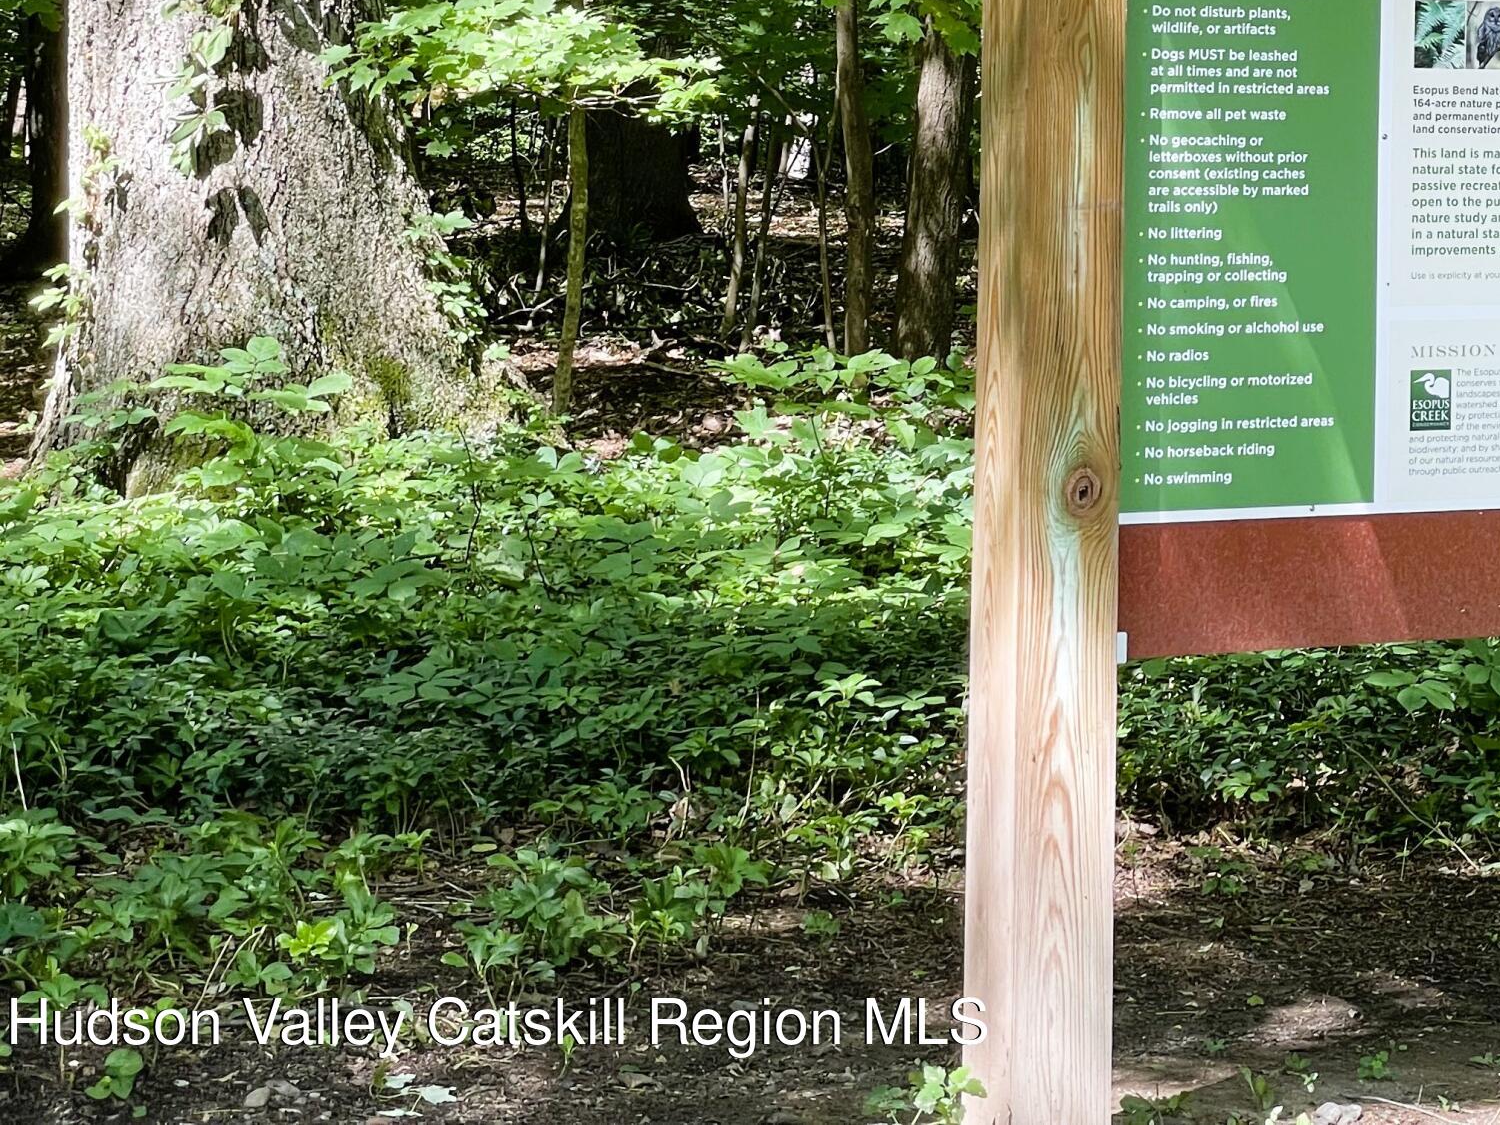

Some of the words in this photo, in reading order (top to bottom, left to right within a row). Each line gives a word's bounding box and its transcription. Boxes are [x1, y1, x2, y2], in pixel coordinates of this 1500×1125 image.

[1152, 4, 1171, 16] Do
[1174, 6, 1196, 17] not
[1199, 5, 1245, 18] disturb
[1248, 6, 1290, 21] plants,
[1151, 21, 1202, 35] wildlife,
[1206, 24, 1221, 34] or
[1223, 22, 1276, 35] artifacts
[1151, 48, 1185, 62] Dogs
[1188, 48, 1226, 60] MUST
[1229, 48, 1245, 60] be
[1248, 49, 1297, 61] leashed
[1150, 81, 1214, 94] permitted
[1218, 81, 1229, 93] in
[1233, 82, 1293, 94] restricted
[1296, 85, 1329, 95] areas
[1413, 85, 1449, 96] Esopus
[1452, 85, 1478, 95] Bend
[1413, 98, 1457, 108] 164-acre
[1460, 99, 1492, 108] nature
[1150, 107, 1202, 119] Remove
[1205, 108, 1221, 119] all
[1224, 109, 1246, 121] pet
[1249, 109, 1286, 120] waste
[1412, 111, 1432, 120] and
[1435, 112, 1499, 123] permanently
[1412, 124, 1434, 133] land
[1150, 134, 1168, 145] No
[1171, 134, 1246, 148] geocaching
[1249, 137, 1263, 146] or
[1412, 180, 1456, 192] passive
[1411, 212, 1450, 223] nature
[1454, 211, 1487, 225] study
[1411, 244, 1496, 257] improvements
[1147, 254, 1166, 265] No
[1170, 253, 1223, 267] hunting,
[1227, 252, 1273, 266] fishing,
[1147, 270, 1203, 284] trapping
[1206, 272, 1221, 281] or
[1224, 269, 1287, 282] collecting
[1147, 297, 1166, 308] No
[1169, 295, 1229, 310] camping,
[1232, 298, 1247, 307] or
[1249, 295, 1278, 307] fires
[1147, 323, 1166, 335] No
[1169, 322, 1224, 336] smoking
[1227, 324, 1242, 334] or
[1245, 320, 1299, 333] alchohol
[1302, 322, 1324, 332] use
[1412, 344, 1496, 358] MISSION
[1146, 377, 1165, 388] No
[1168, 375, 1226, 389] bicycling
[1230, 376, 1244, 386] or
[1247, 372, 1312, 386] motorized
[1145, 392, 1198, 405] vehicles
[1412, 399, 1449, 409] ESOPUS
[1411, 409, 1448, 421] CREEK
[1144, 447, 1163, 458] No
[1167, 444, 1234, 458] horseback
[1237, 443, 1274, 456] riding
[1144, 473, 1163, 485] No
[1166, 471, 1232, 484] swimming
